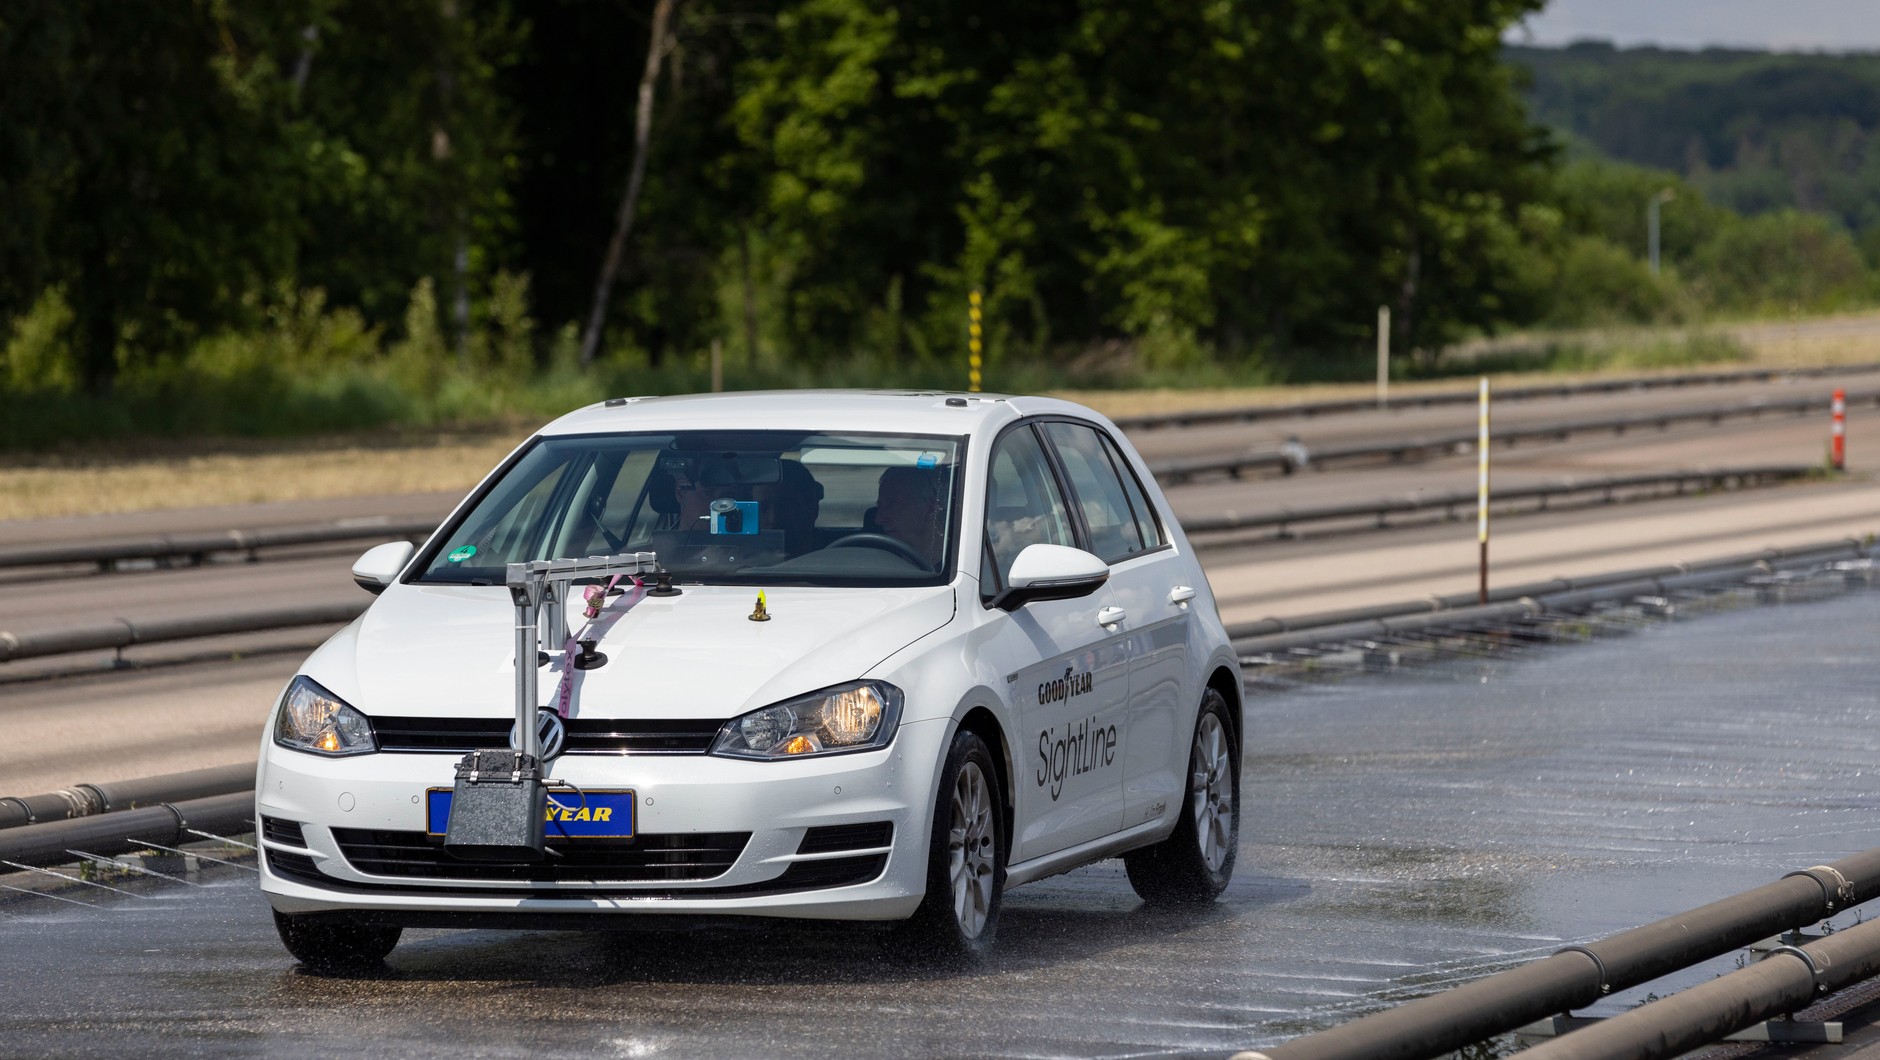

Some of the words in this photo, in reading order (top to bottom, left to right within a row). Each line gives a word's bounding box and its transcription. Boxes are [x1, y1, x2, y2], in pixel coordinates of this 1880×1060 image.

[560, 649, 574, 714] olytex
[1038, 671, 1093, 705] GOODYEAR
[1037, 716, 1117, 801] SightLine
[546, 807, 613, 822] YEAR
